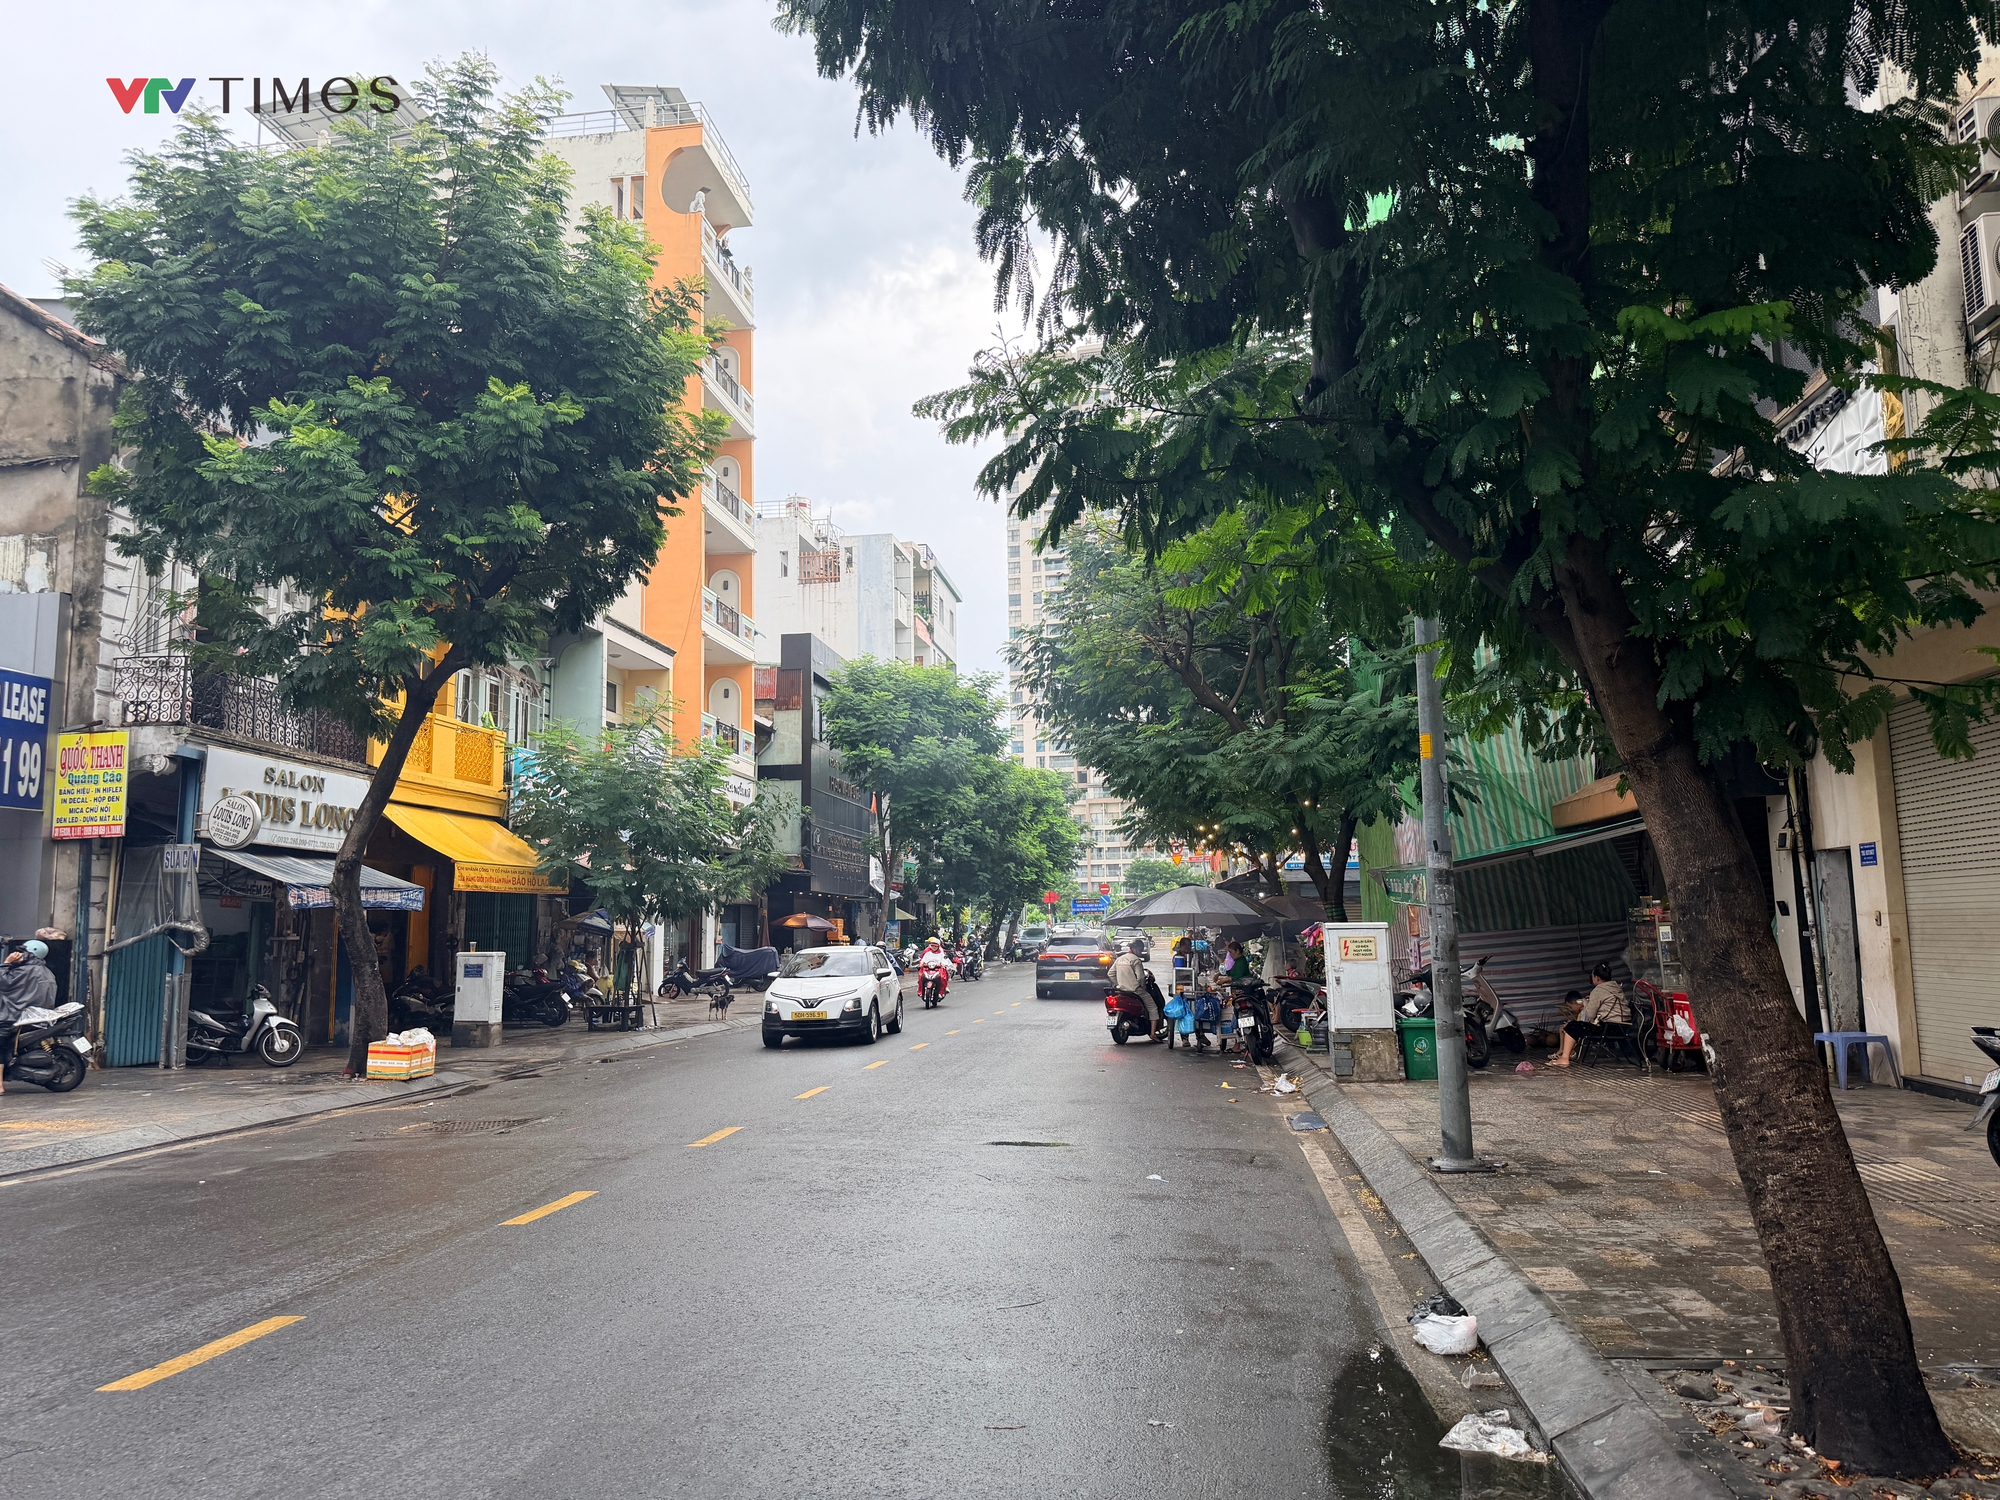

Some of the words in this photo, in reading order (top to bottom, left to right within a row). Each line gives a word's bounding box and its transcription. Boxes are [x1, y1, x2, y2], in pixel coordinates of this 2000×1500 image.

[3, 681, 46, 724] LEASE
[60, 735, 88, 778] QUỐC
[90, 745, 125, 770] THANH
[17, 740, 42, 798] 99
[68, 770, 99, 787] Quảng
[263, 766, 327, 793] SALON
[102, 786, 123, 794] HIFLEX
[69, 806, 84, 814] MICA
[226, 799, 247, 813] SALON
[213, 805, 233, 824] LOUIS
[231, 812, 251, 830] LONG
[512, 874, 526, 885] BẢO
[527, 875, 536, 887] HỘ
